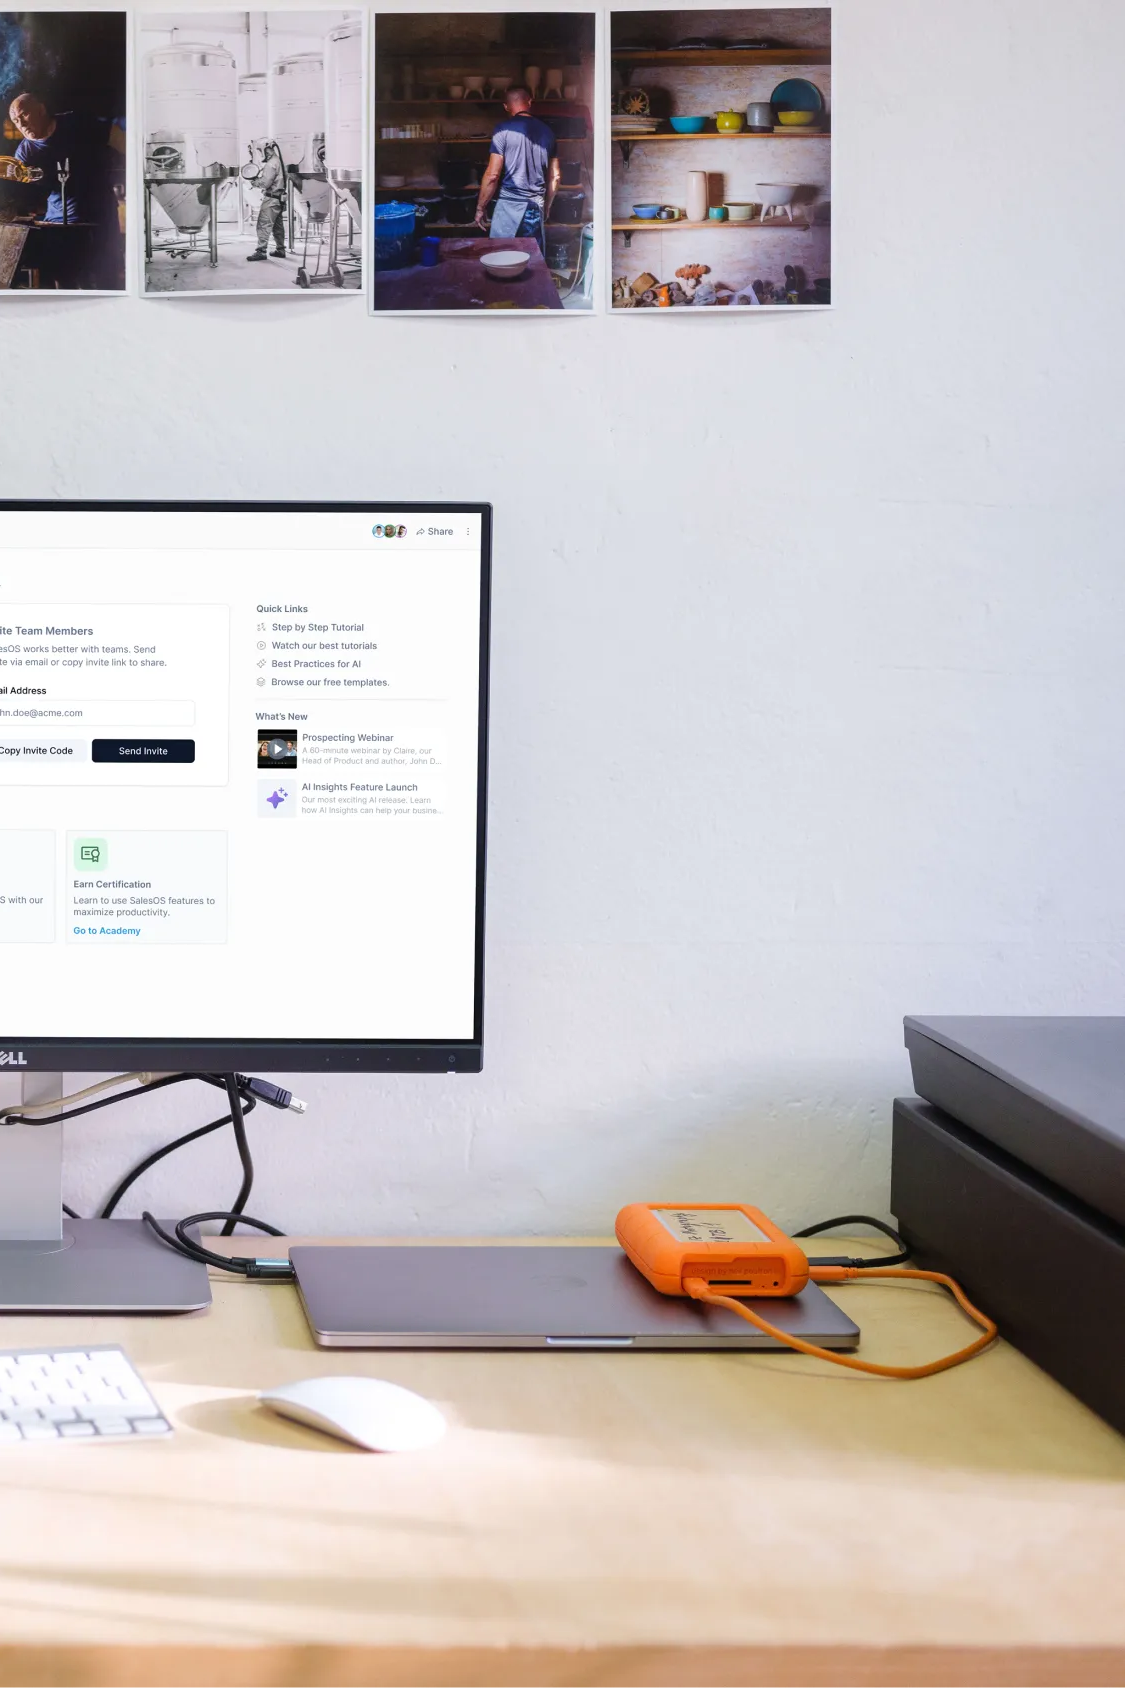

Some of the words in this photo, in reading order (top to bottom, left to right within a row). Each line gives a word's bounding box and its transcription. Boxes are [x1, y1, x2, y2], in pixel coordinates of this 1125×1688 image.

[427, 527, 454, 536] Share
[256, 604, 283, 613] Quick
[284, 604, 308, 613] Links
[15, 626, 43, 636] Team
[45, 626, 94, 636] Members
[272, 623, 293, 633] Step
[294, 623, 306, 633] by
[308, 623, 329, 633] Step
[330, 623, 364, 632] Tutorial
[22, 645, 50, 653] works
[51, 645, 79, 654] better
[80, 645, 100, 654] with
[101, 645, 131, 654] teams.
[133, 645, 156, 654] Send
[271, 641, 300, 650] Watch
[319, 641, 339, 650] best
[341, 641, 378, 650] tutorials
[9, 657, 23, 666] via
[25, 657, 49, 666] email
[50, 659, 60, 667] or
[61, 659, 84, 668] copy
[85, 658, 110, 667] invite
[111, 658, 127, 667] link
[129, 659, 139, 667] to
[140, 658, 167, 667] share.
[271, 659, 292, 668] Best
[293, 659, 335, 668] Practices
[337, 659, 350, 668] for
[351, 660, 361, 668] AI
[271, 677, 305, 686] Browse
[323, 677, 342, 687] free
[343, 678, 390, 688] templates.
[9, 686, 47, 695] Address
[288, 712, 308, 721] New
[302, 733, 356, 744] Prospecting
[357, 733, 394, 742] Webinar
[23, 746, 48, 755] Invite
[49, 746, 73, 755] Code
[119, 746, 142, 755] Send
[144, 747, 168, 755] Invite
[309, 746, 349, 754] 60-minute
[382, 747, 392, 756] by
[393, 747, 417, 755] Claire,
[301, 783, 311, 791] AI
[313, 782, 348, 793] Insights
[350, 783, 384, 792] Feature
[385, 783, 418, 792] Launch
[73, 880, 94, 888] Earn
[95, 880, 152, 889] Certification
[7, 895, 27, 904] with
[73, 896, 98, 905] Learn
[100, 897, 110, 905] to
[129, 896, 166, 905] SalesOS
[168, 896, 204, 905] features
[206, 897, 216, 905] to
[73, 907, 114, 916] maximize
[116, 908, 170, 918] productivity.
[73, 926, 86, 935] Go
[88, 927, 98, 935] to
[99, 926, 141, 937] Academy
